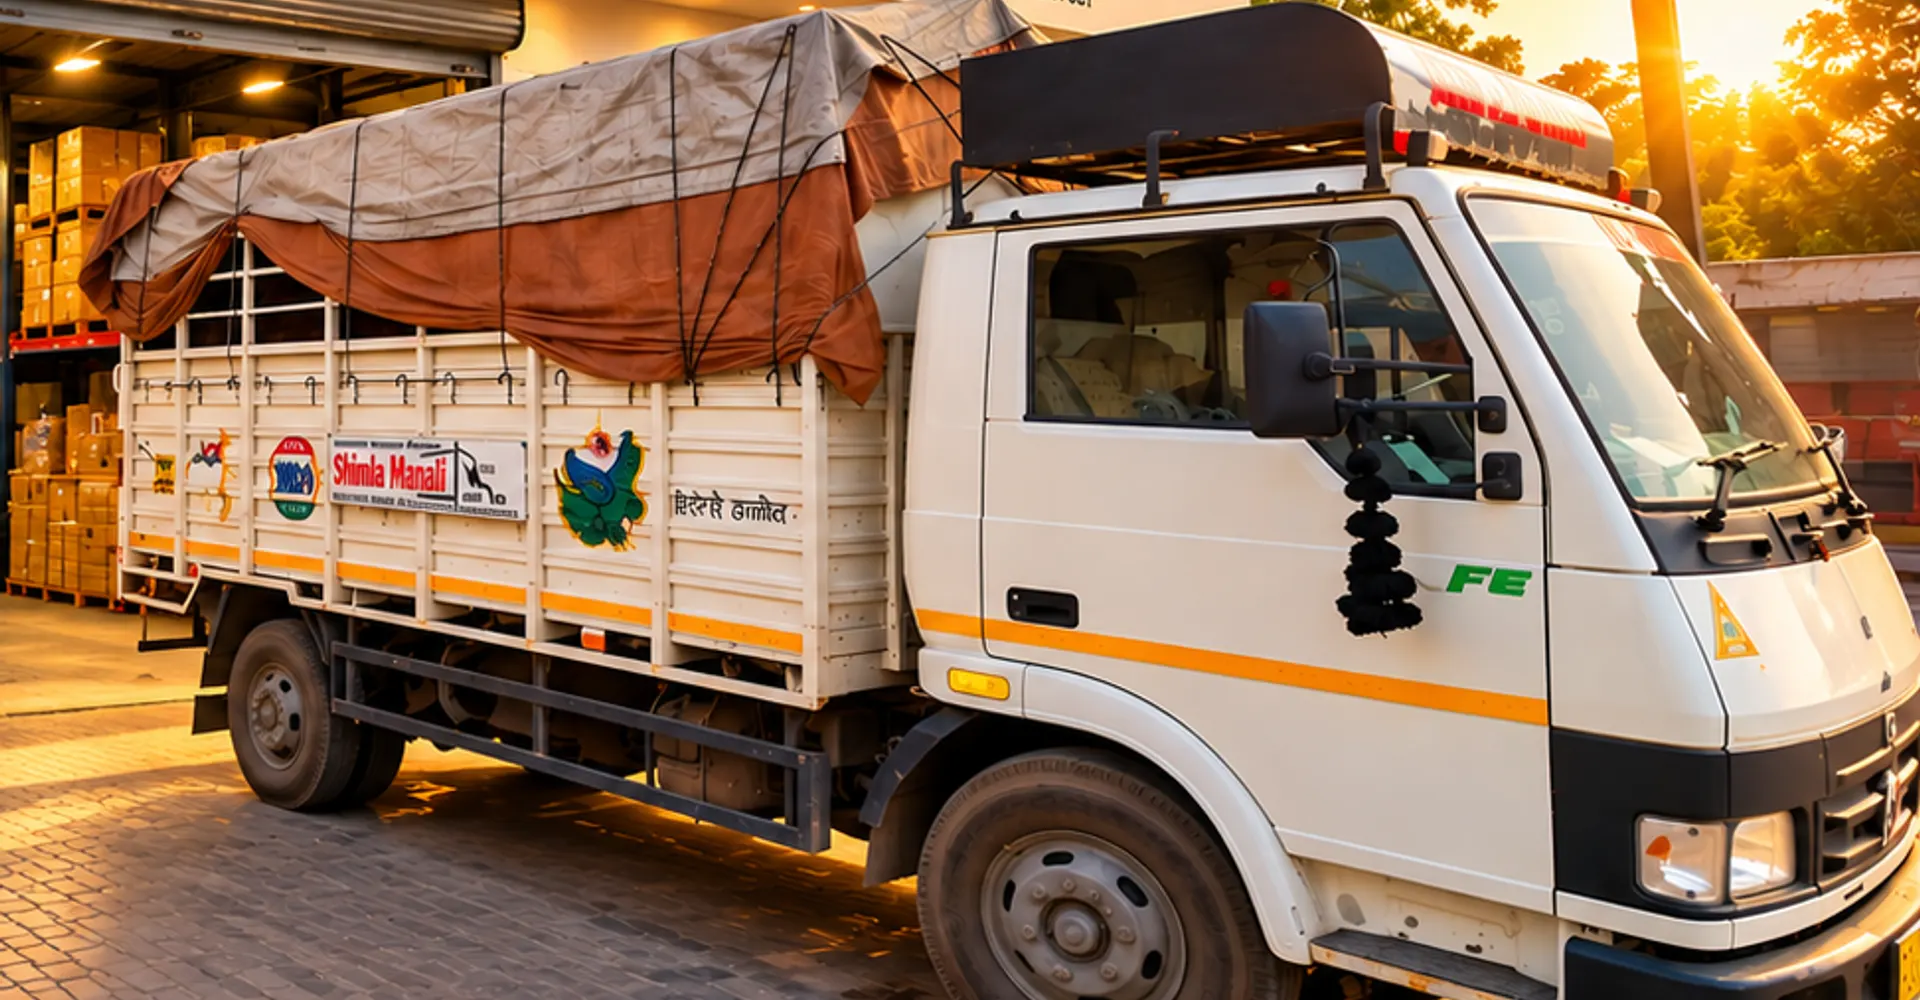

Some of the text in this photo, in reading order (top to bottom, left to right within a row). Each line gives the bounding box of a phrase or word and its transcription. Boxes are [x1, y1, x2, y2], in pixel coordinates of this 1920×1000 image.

[333, 452, 384, 489] Shimla
[389, 454, 447, 492] Manali
[1446, 564, 1532, 597] FE
